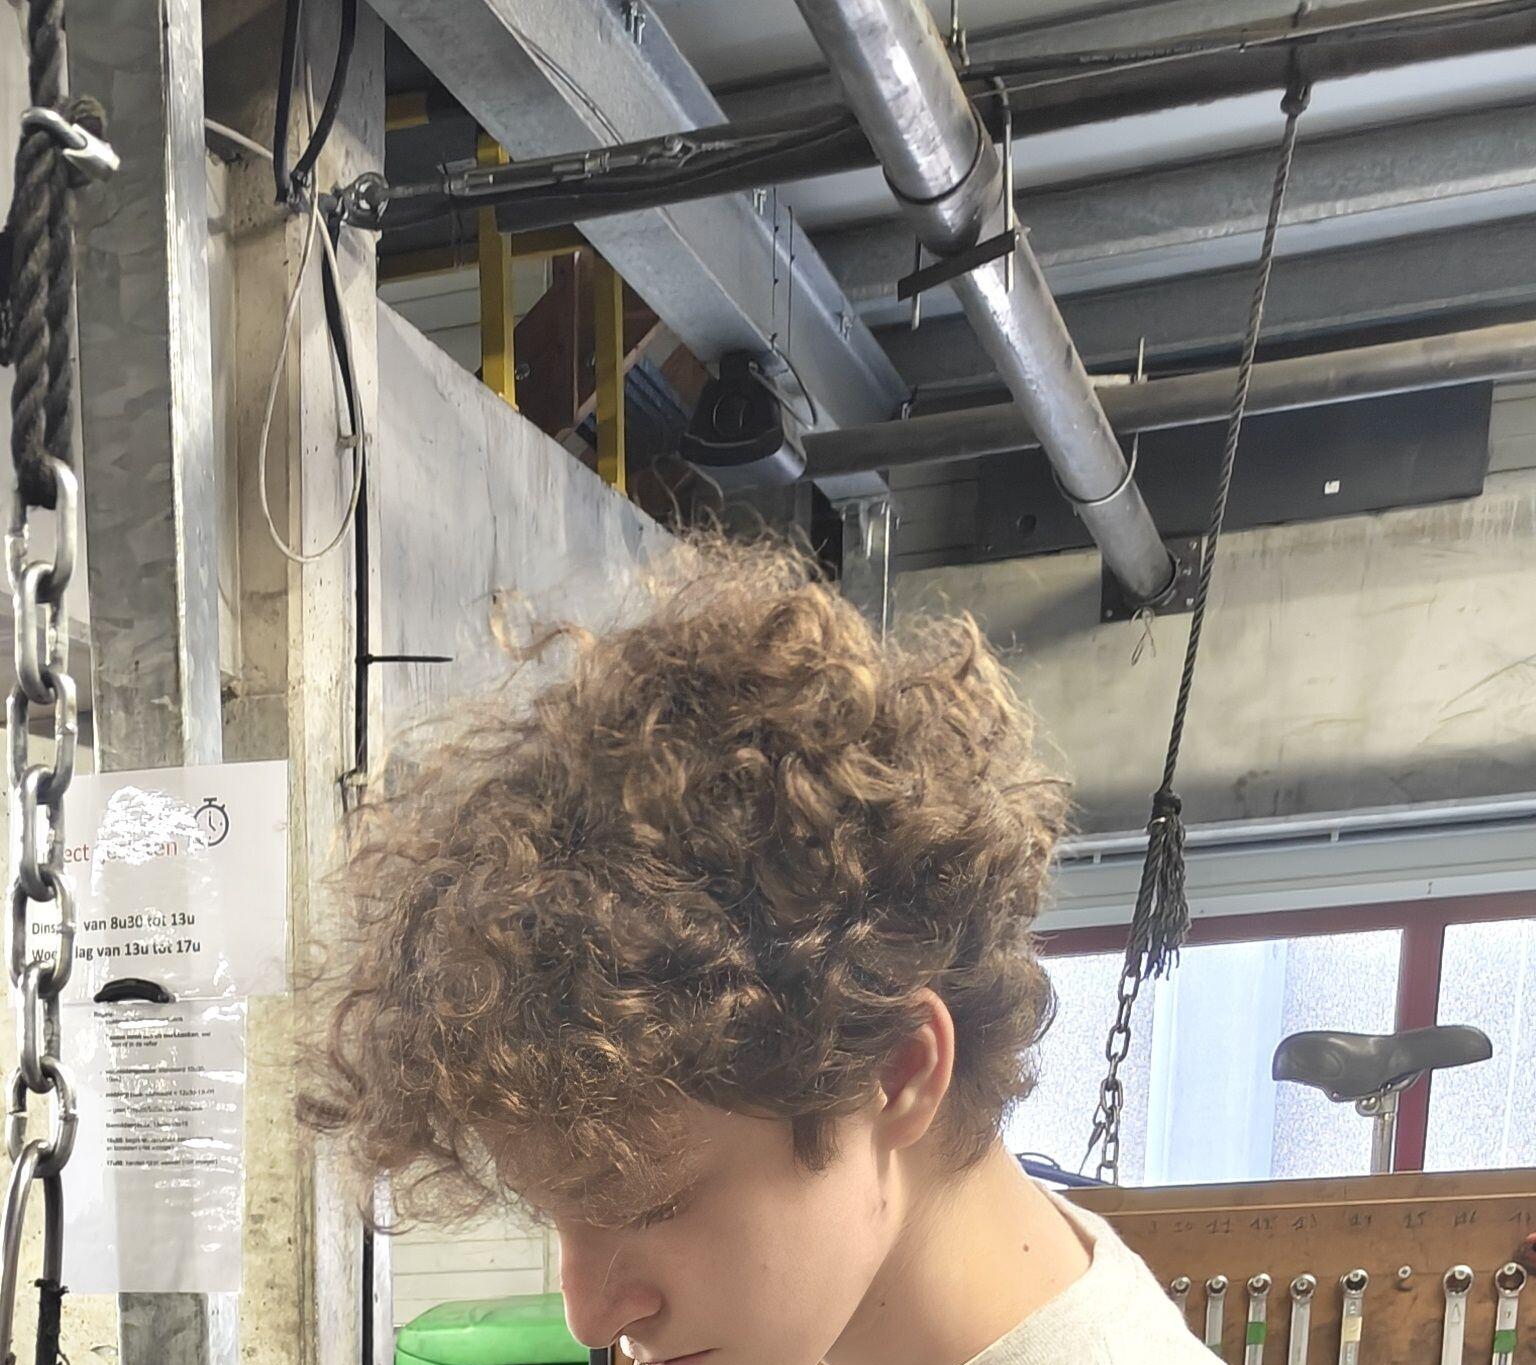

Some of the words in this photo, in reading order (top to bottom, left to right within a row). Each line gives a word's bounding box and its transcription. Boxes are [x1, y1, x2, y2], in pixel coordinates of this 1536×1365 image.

[84, 918, 107, 932] van
[110, 914, 144, 929] 8u30
[171, 911, 196, 926] 13u
[97, 944, 121, 958] van
[124, 942, 150, 956] 13u
[153, 941, 174, 955] tot
[176, 939, 201, 955] 17u
